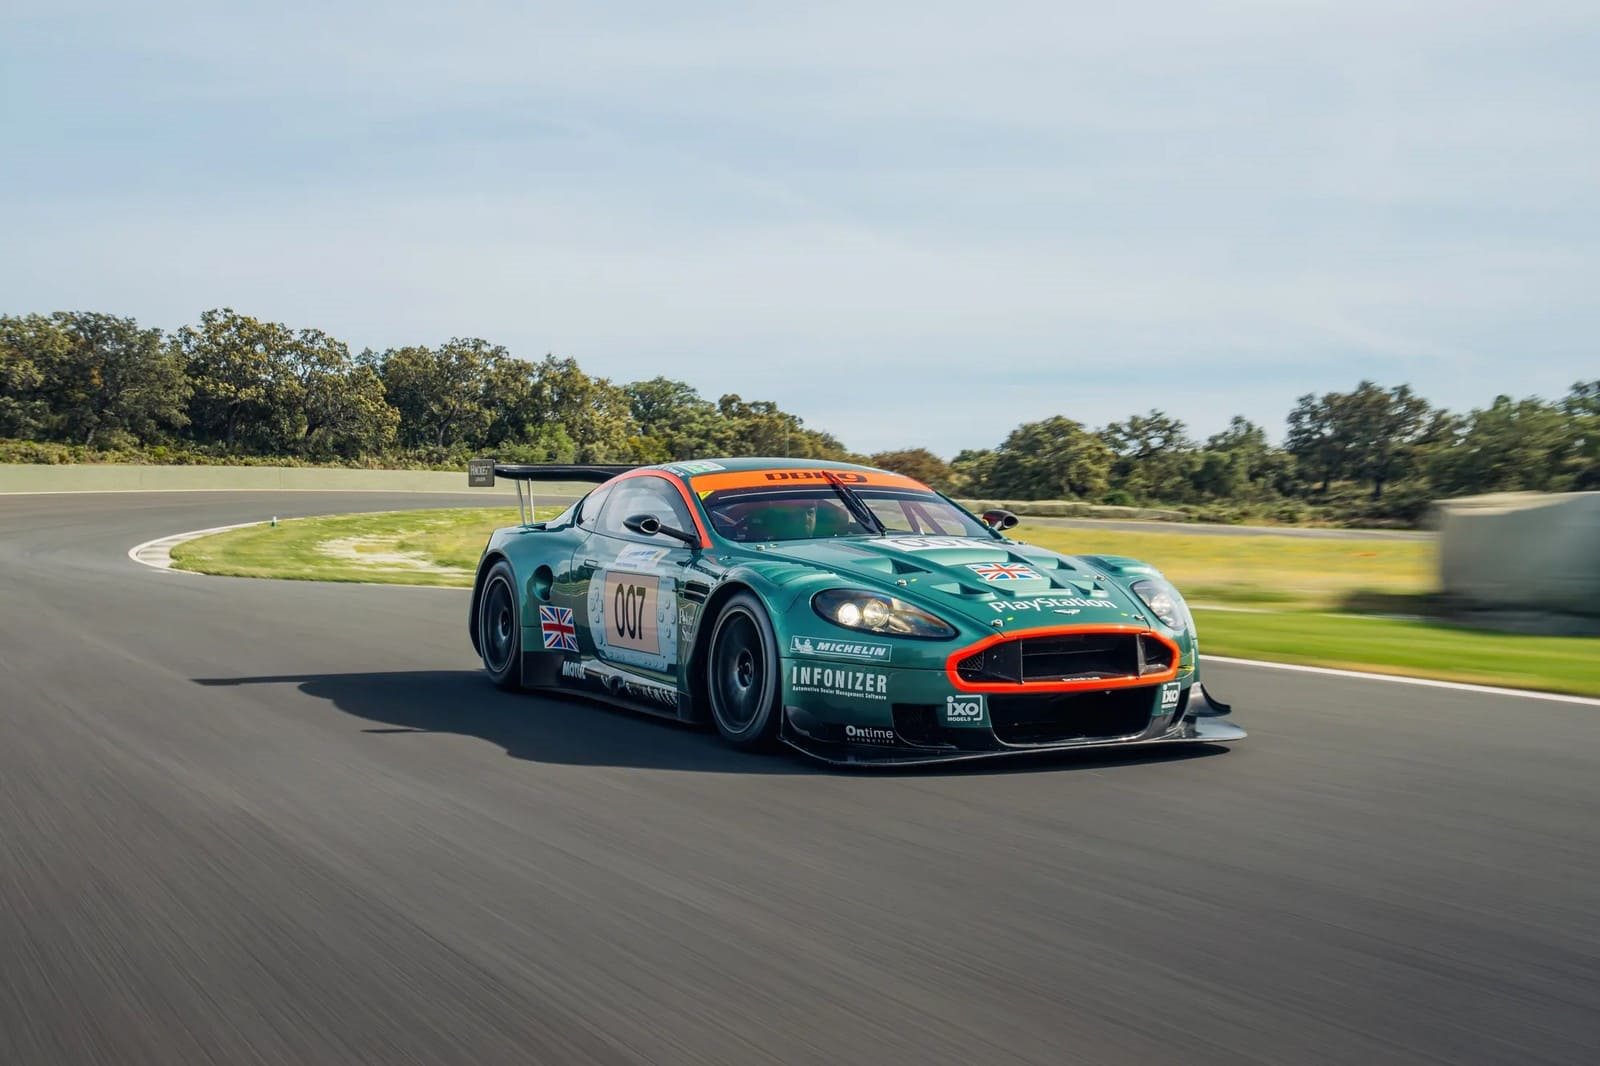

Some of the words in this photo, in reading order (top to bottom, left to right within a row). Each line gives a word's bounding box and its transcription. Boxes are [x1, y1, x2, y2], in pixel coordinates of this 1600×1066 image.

[615, 583, 646, 640] 007
[988, 597, 1118, 612] PlayStation
[816, 642, 886, 656] MICHELIN
[792, 666, 887, 693] INFONIZER
[792, 685, 820, 693] Automotive
[835, 689, 865, 698] Management
[865, 692, 887, 700] Software
[845, 725, 894, 739] Ontime
